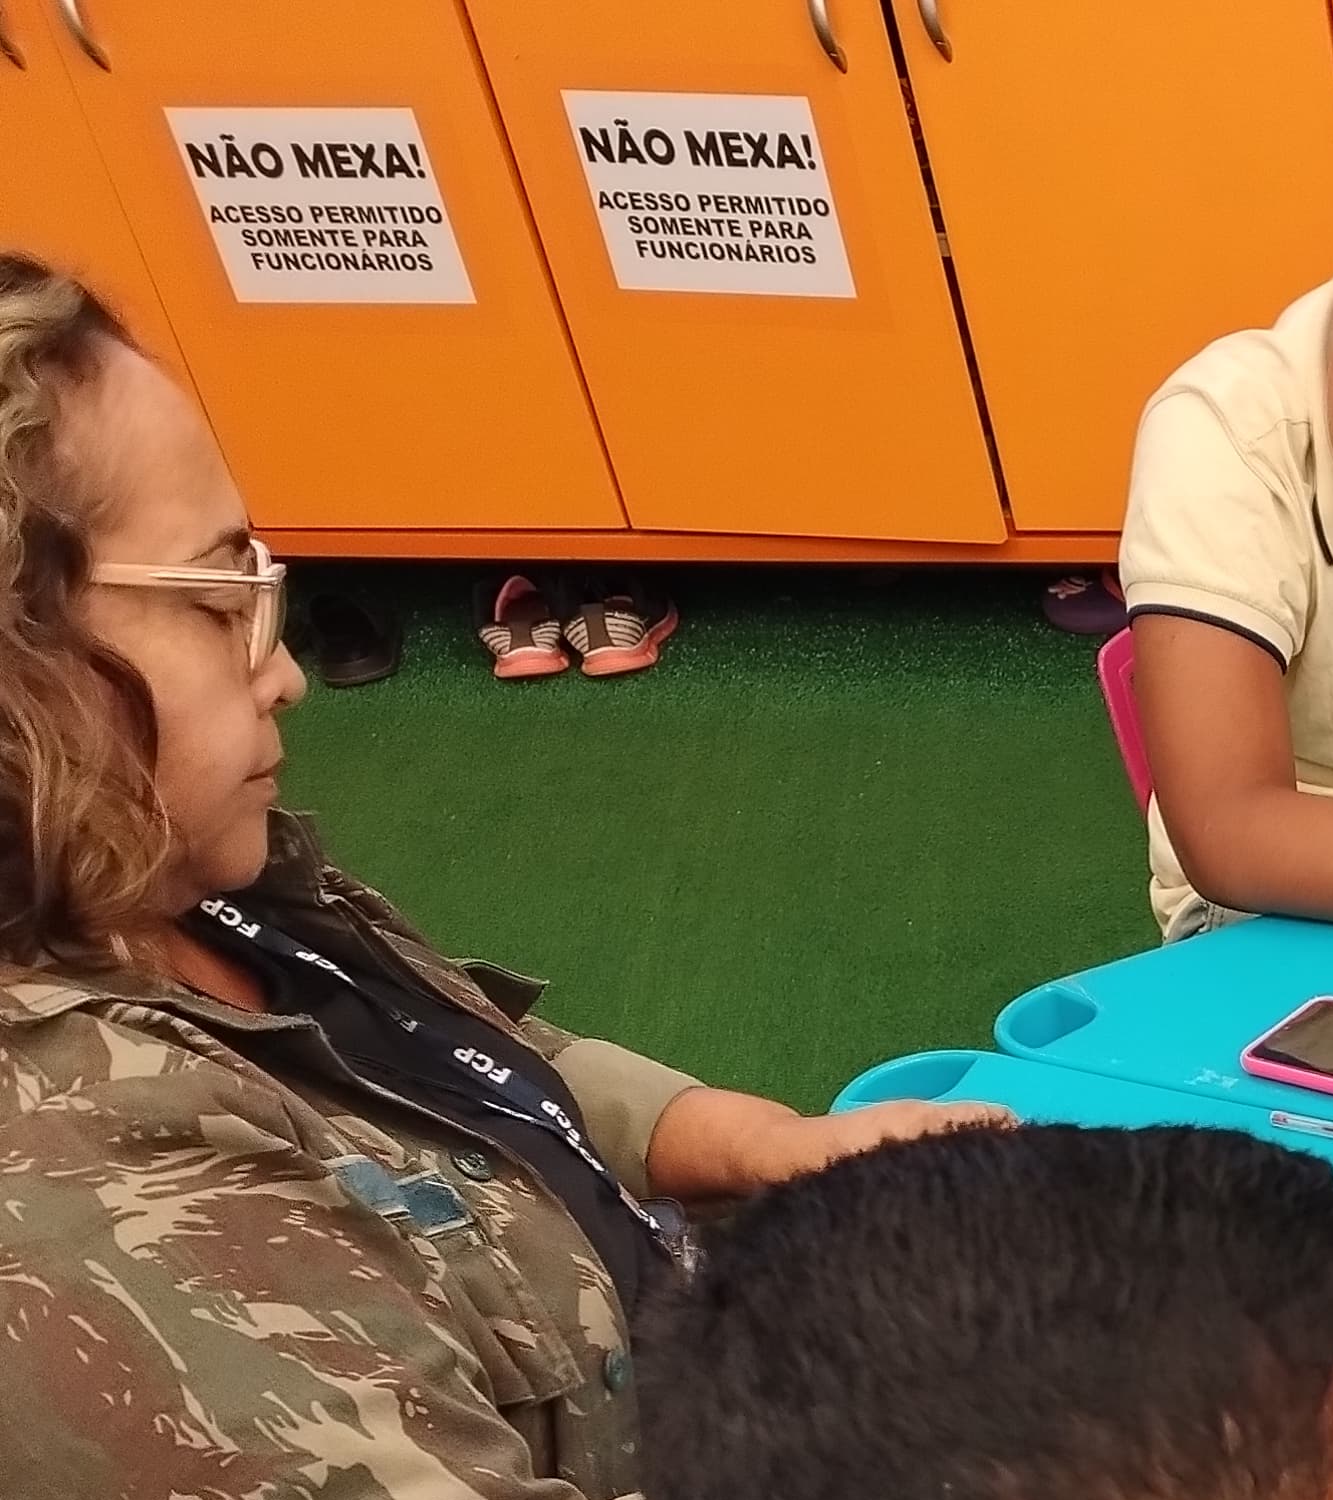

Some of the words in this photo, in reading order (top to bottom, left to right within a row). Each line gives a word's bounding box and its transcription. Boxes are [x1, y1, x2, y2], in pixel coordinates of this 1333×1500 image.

[184, 133, 284, 179] NÃO
[290, 143, 426, 179] MEXA!
[578, 118, 676, 166] NÃO
[683, 130, 817, 171] MEXA!
[209, 205, 304, 224] ACESSO
[309, 205, 443, 225] PERMITIDO
[598, 191, 691, 212] ACESSO
[697, 194, 830, 217] PERMITIDO
[241, 228, 358, 248] SOMENTE
[362, 229, 429, 248] PARA
[627, 215, 744, 238] SOMENTE
[748, 219, 813, 241] PARA
[250, 248, 434, 272] FUNCIONÁRIOS
[635, 236, 817, 265] FUNCIONÁRIOS
[200, 898, 262, 940] FCP
[453, 1046, 513, 1085] FCP
